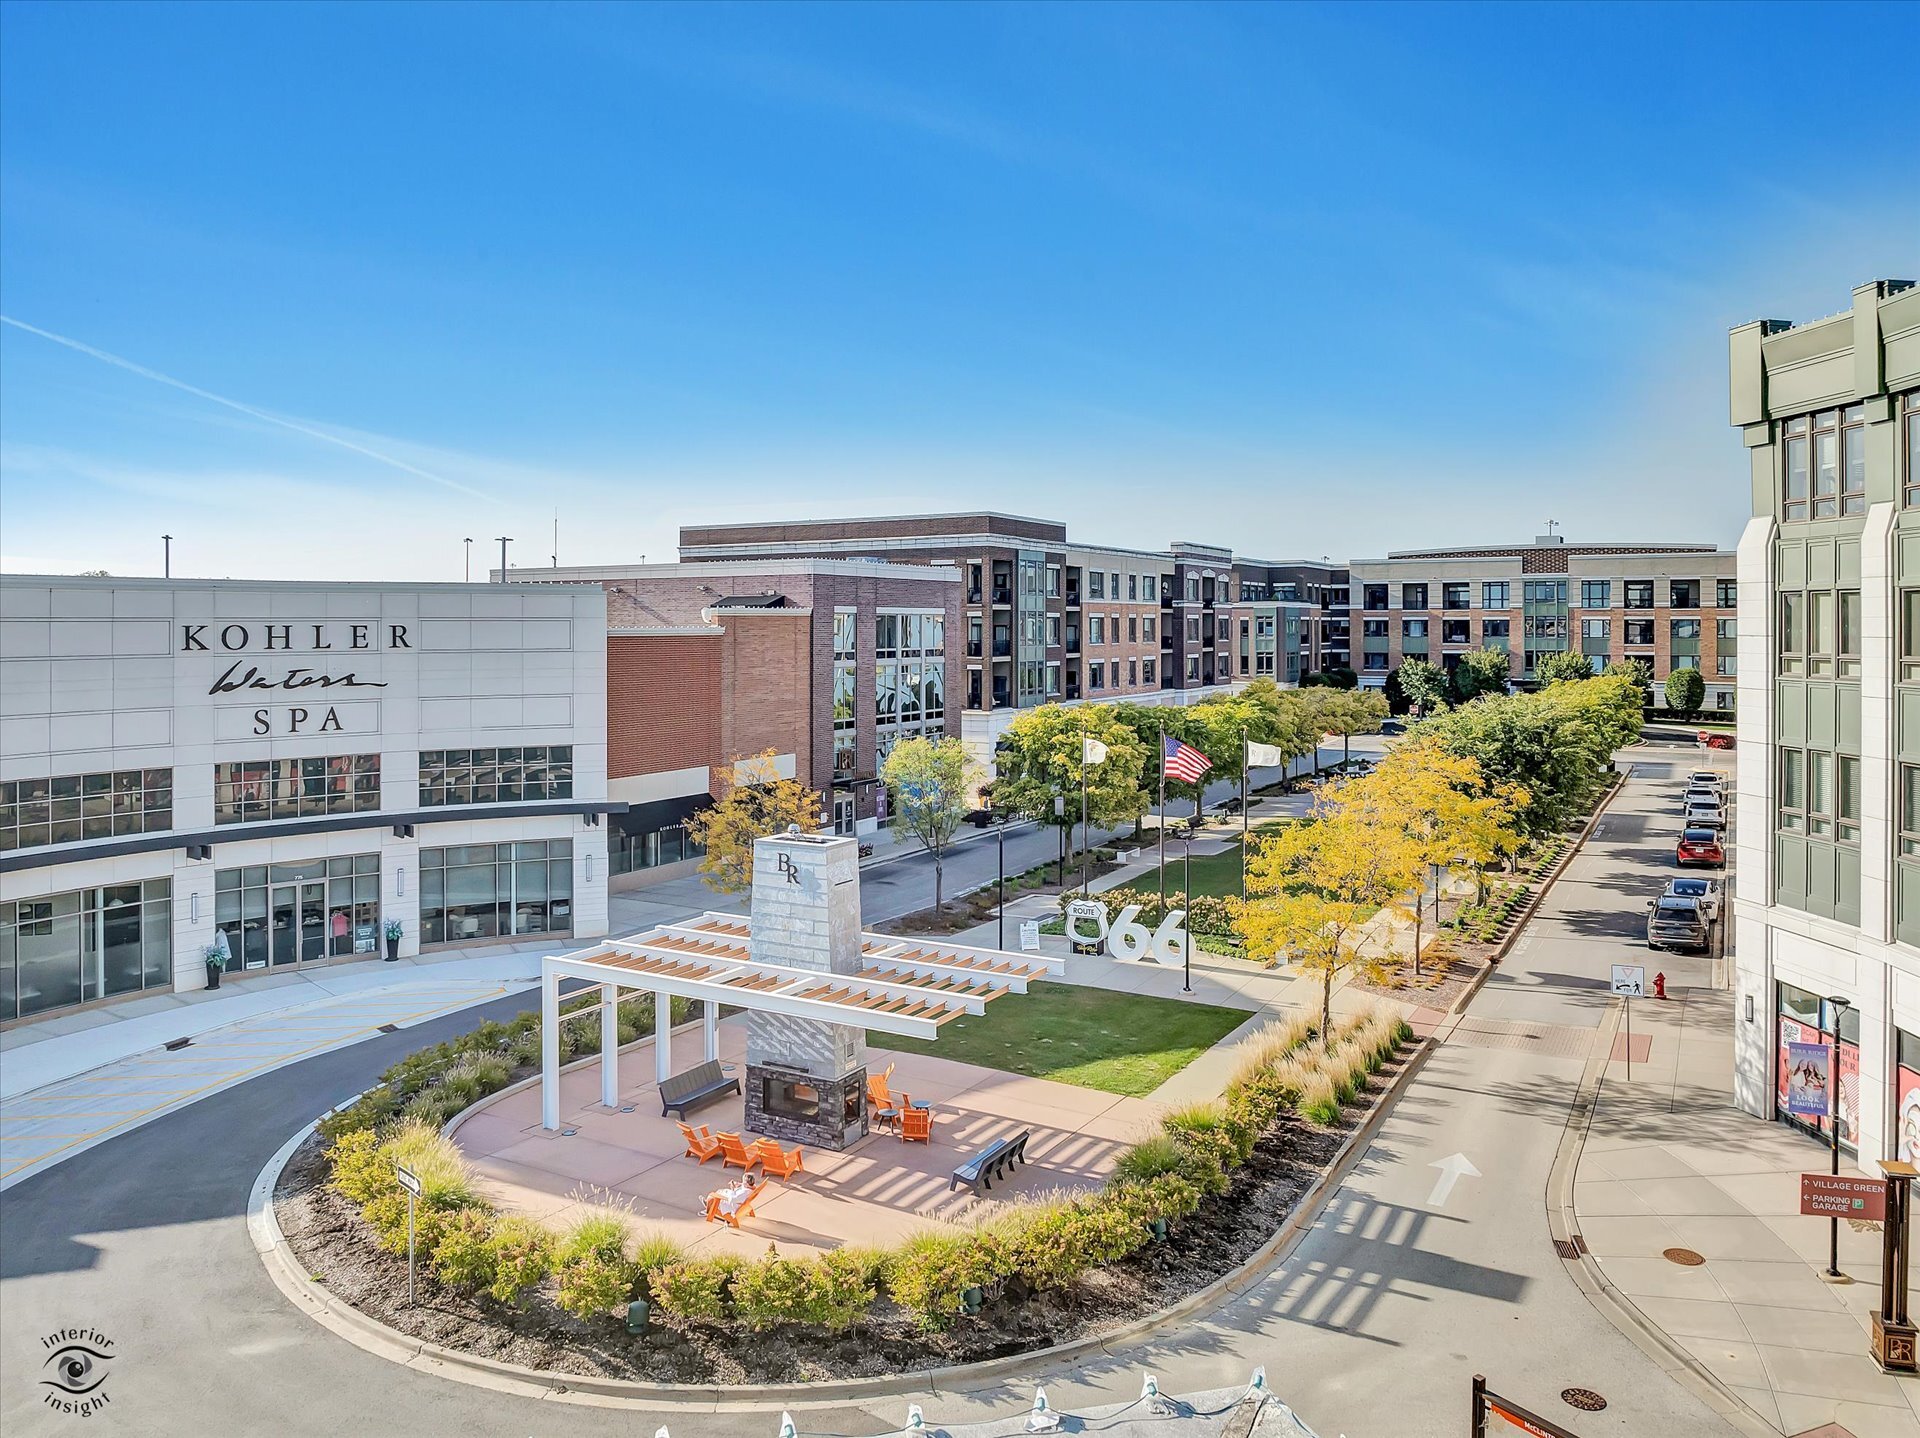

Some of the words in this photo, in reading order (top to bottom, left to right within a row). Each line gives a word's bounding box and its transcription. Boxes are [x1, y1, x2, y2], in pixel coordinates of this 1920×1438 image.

[181, 624, 413, 651] KOHLER
[208, 660, 389, 695] Waters
[253, 706, 344, 735] SPA
[777, 852, 801, 885] BR
[1073, 907, 1095, 915] ROUTE
[1108, 905, 1196, 968] 66
[1791, 1100, 1825, 1109] BEAUTIFUL
[1796, 1094, 1820, 1103] LOOK
[1812, 1180, 1851, 1191] VILLAGE
[1853, 1184, 1885, 1193] GREEN
[1812, 1194, 1851, 1205] PARKING
[1812, 1202, 1849, 1212] GARAGE
